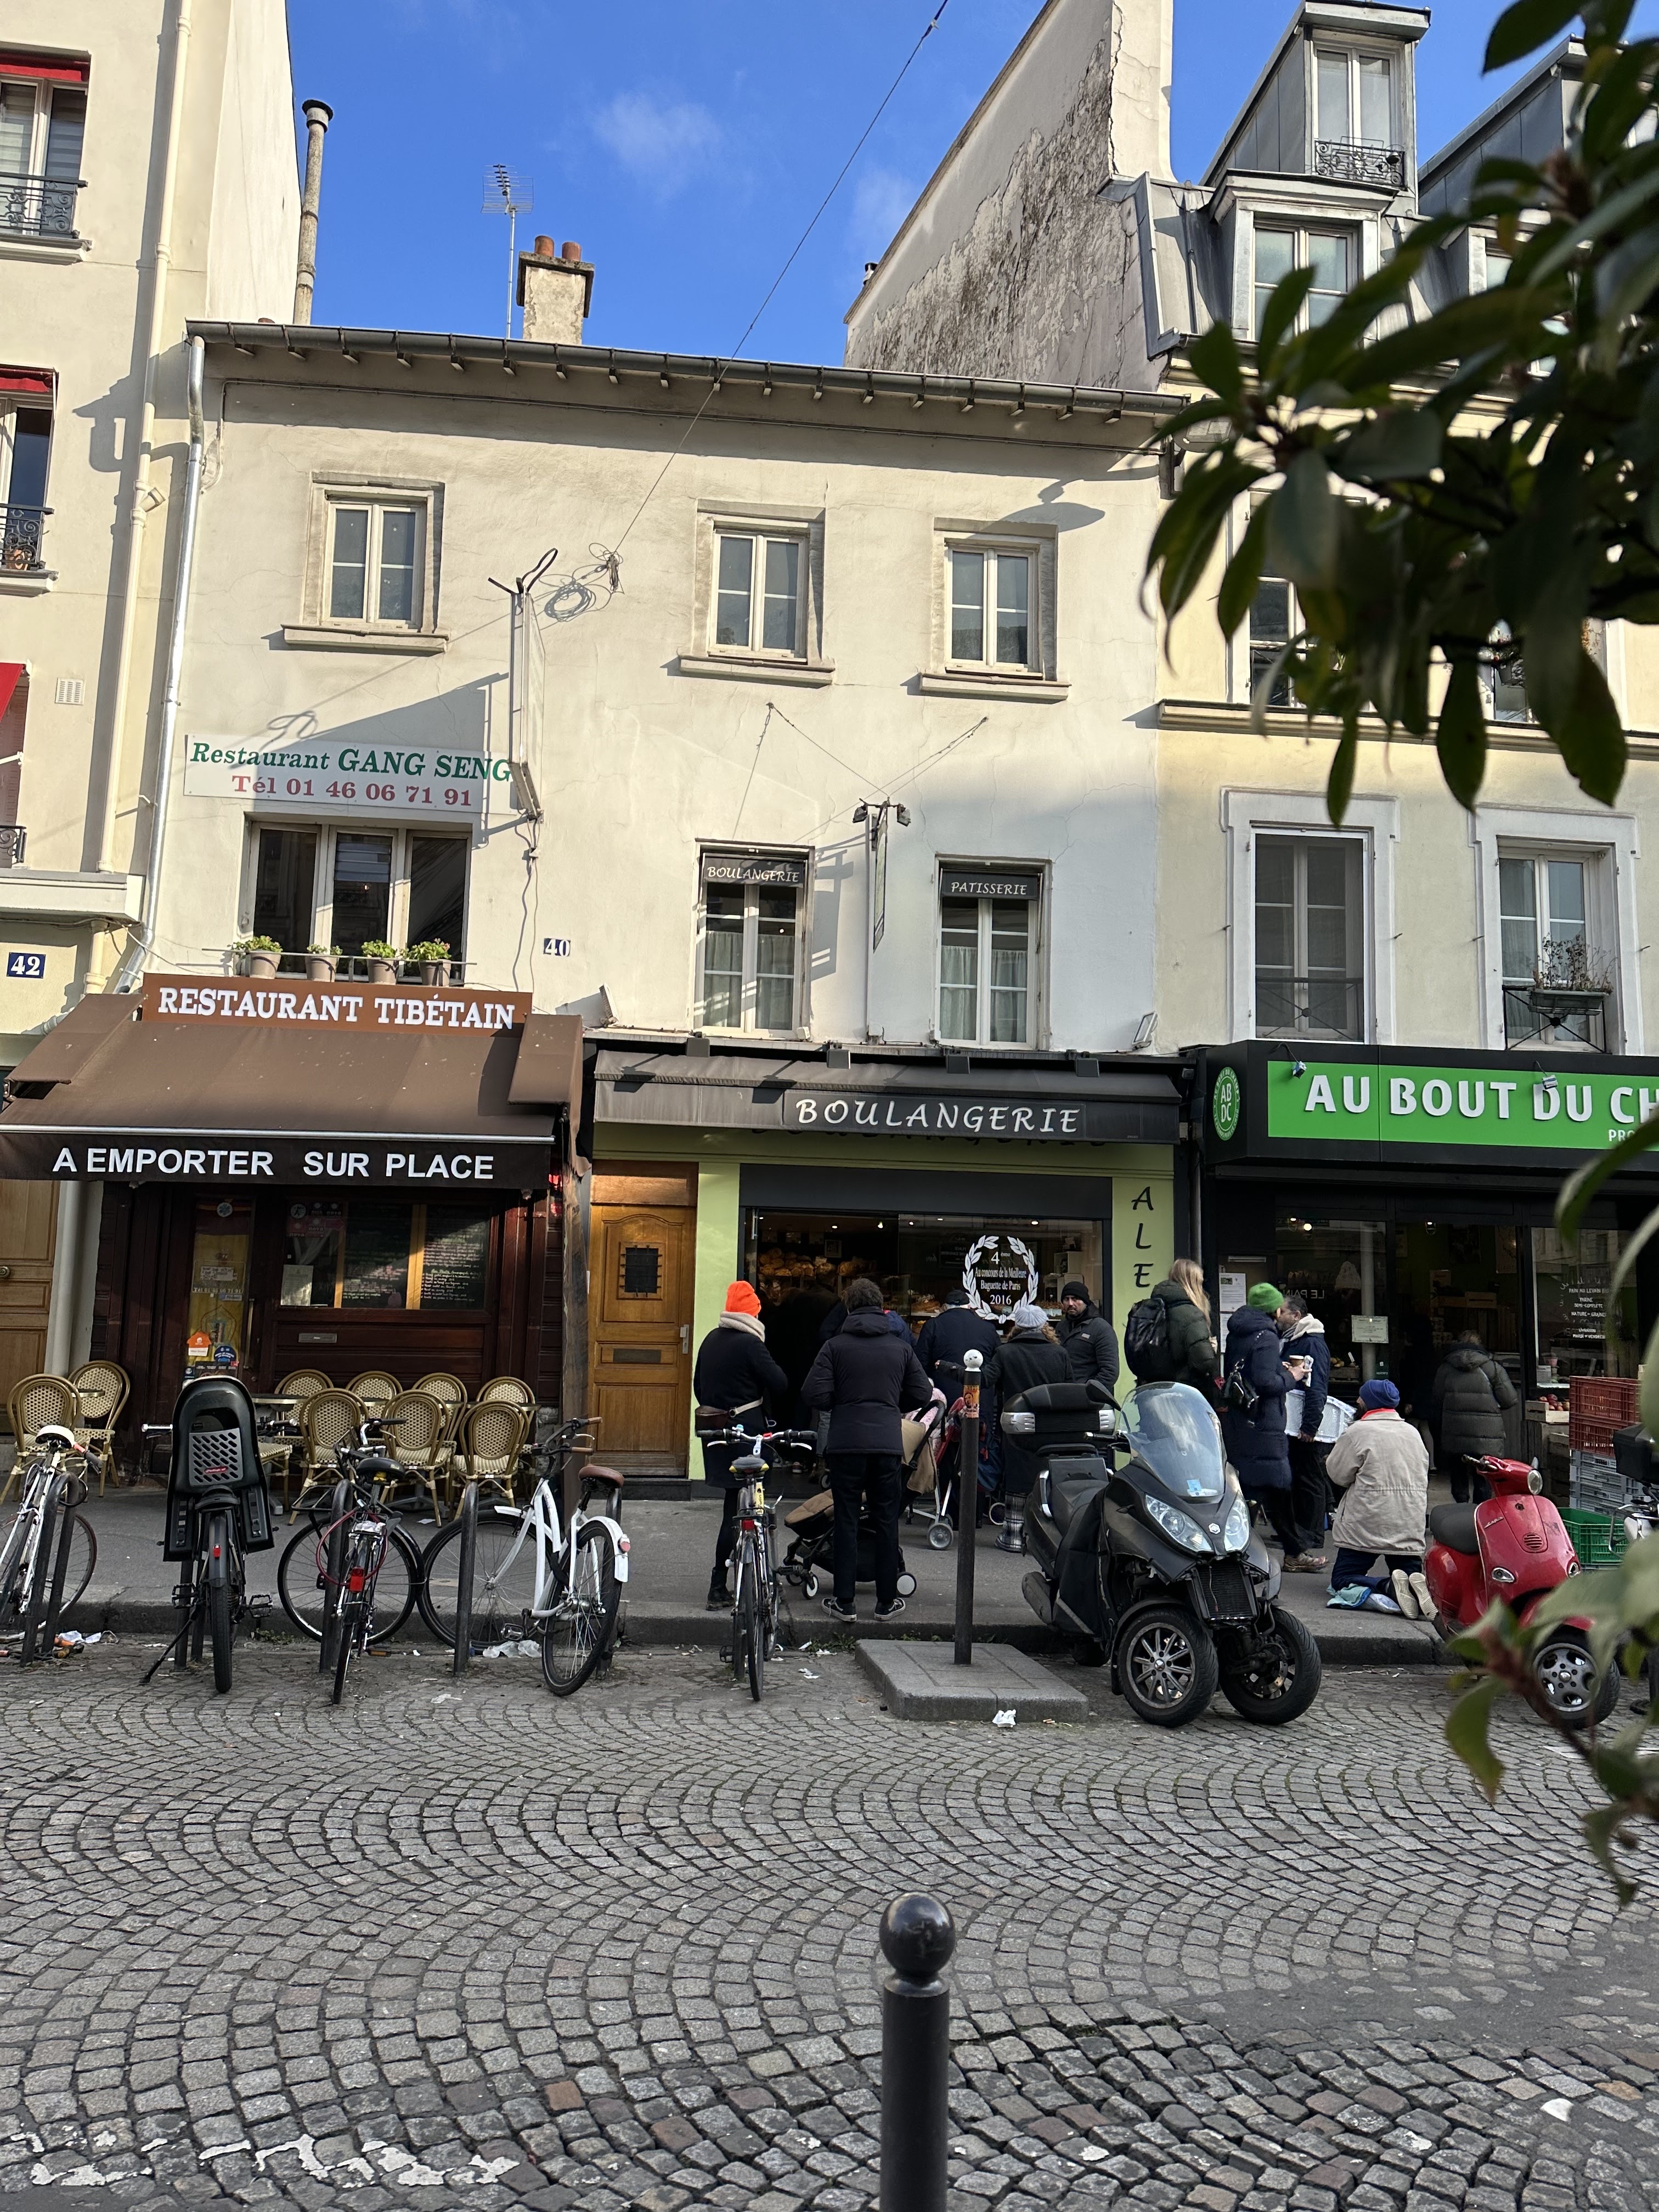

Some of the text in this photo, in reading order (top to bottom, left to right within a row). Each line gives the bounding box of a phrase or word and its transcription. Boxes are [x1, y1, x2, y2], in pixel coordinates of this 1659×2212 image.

[190, 742, 511, 782] Restaurant GANG SENG
[232, 775, 472, 806] Tél 01 46 06 71 91
[707, 866, 800, 884] BOULANGERIE
[951, 881, 1029, 896] PATISSERIE
[545, 939, 569, 956] 40
[11, 954, 41, 976] 42
[158, 988, 515, 1030] RESTAURANT TIBÉTAIN
[1221, 1083, 1232, 1103] AB
[1305, 1075, 1370, 1113] AU
[1389, 1077, 1517, 1119] BOUT
[1533, 1082, 1593, 1123] DU
[795, 1098, 1081, 1133] BOULANGERIE
[1221, 1103, 1232, 1123] DC
[52, 1147, 494, 1180] A EMPORTER SUR PLACE
[991, 1251, 1000, 1264] 4
[975, 1267, 1027, 1278] Au concours de la Meilleure
[980, 1279, 1021, 1292] Baguette de Paris
[990, 1295, 1012, 1305] 2016
